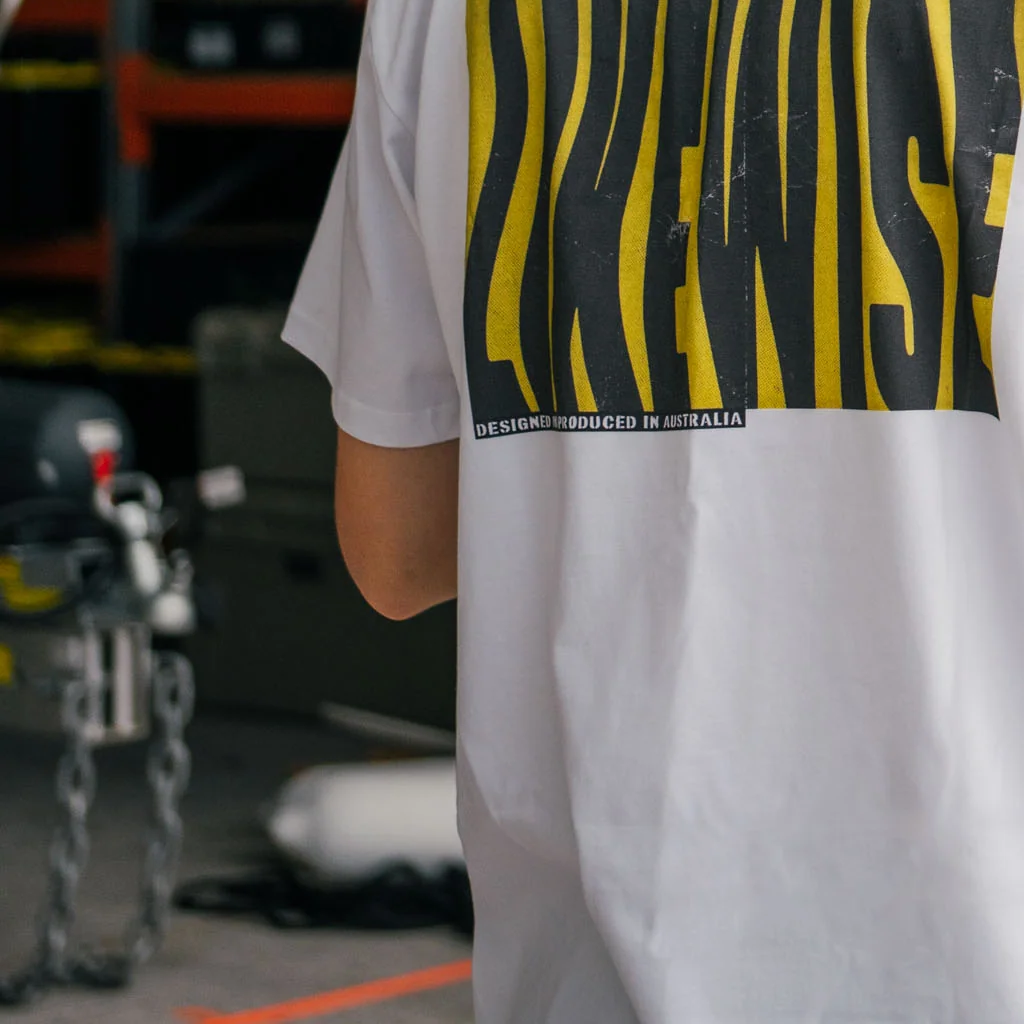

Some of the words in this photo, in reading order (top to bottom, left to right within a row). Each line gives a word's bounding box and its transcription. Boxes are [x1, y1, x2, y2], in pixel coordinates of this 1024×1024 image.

[476, 414, 551, 438] DESIGNED
[557, 414, 637, 430] PRODUCED
[643, 414, 660, 429] IN
[663, 411, 743, 429] AUSTRALIA
